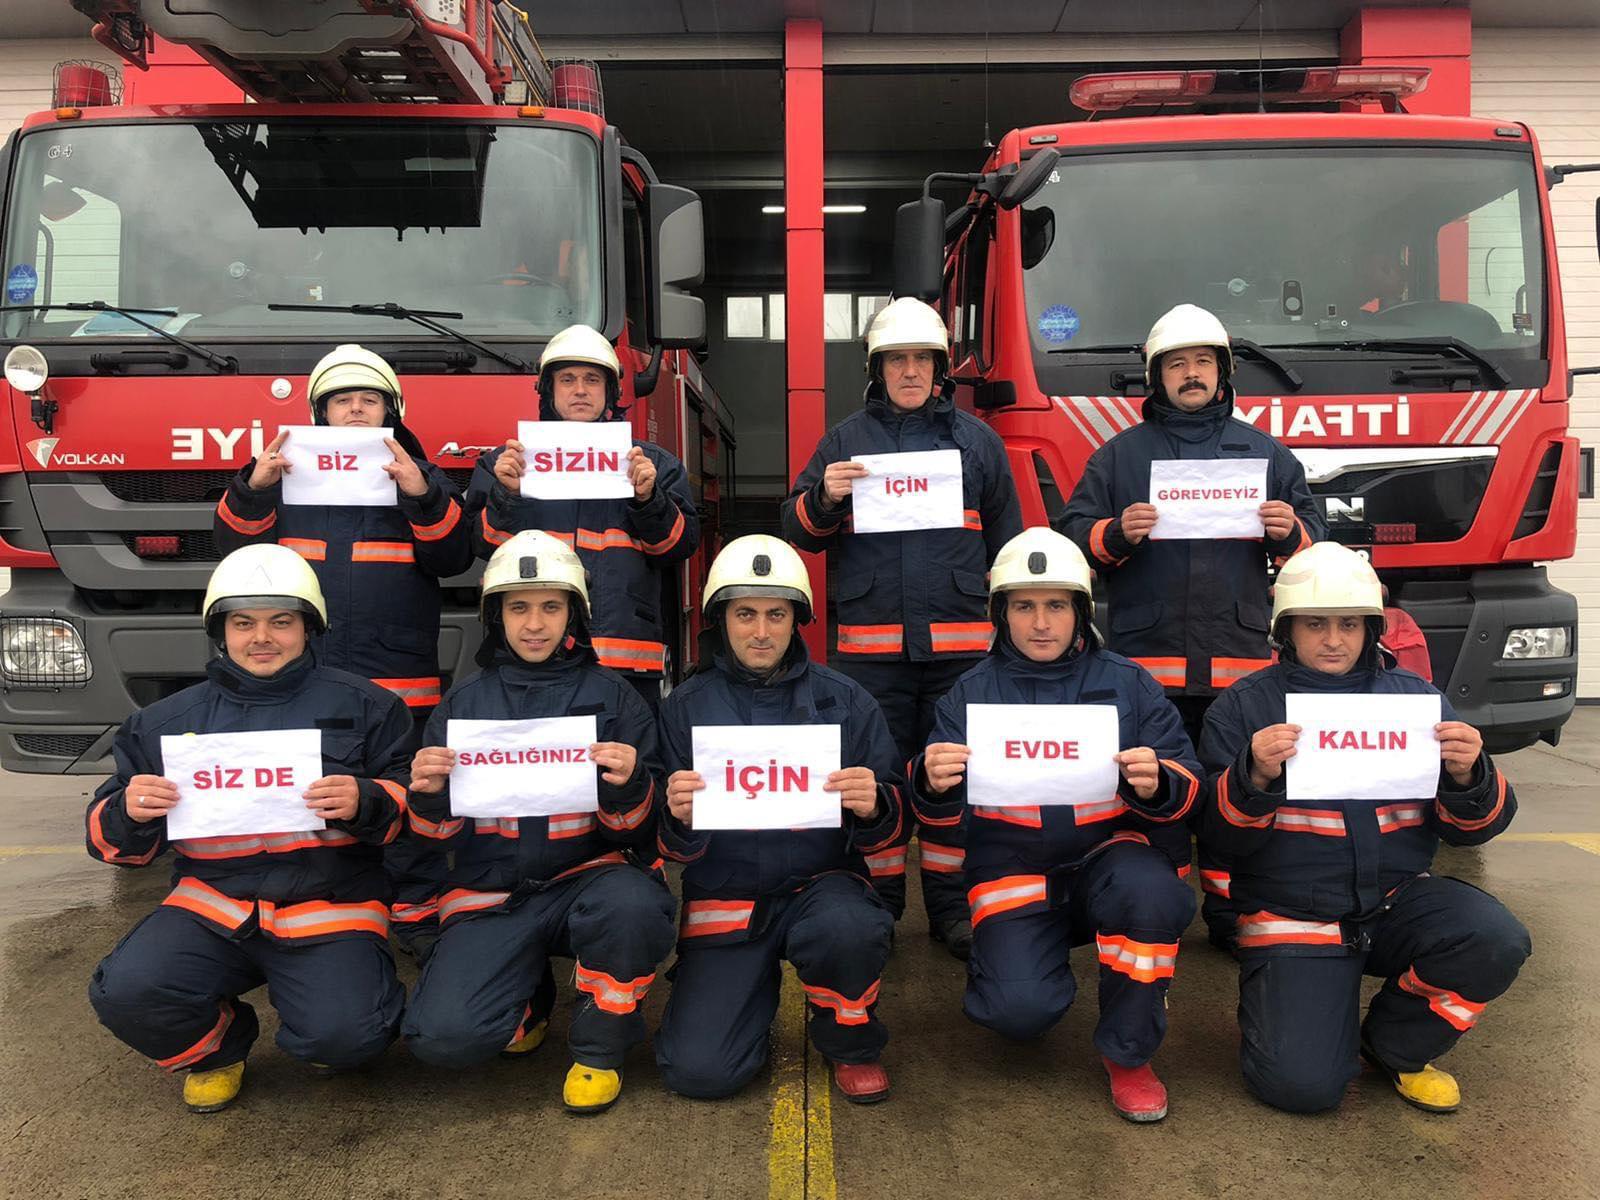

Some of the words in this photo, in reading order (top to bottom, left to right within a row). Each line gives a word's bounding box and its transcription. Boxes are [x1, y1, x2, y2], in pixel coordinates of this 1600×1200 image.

[53, 453, 125, 465] VOLKAN
[317, 454, 358, 472] BİZ
[534, 447, 619, 473] SİZİN
[885, 477, 929, 496] İÇİN
[1157, 486, 1259, 500] GÖREVDEYİZ
[1004, 740, 1079, 760] EVDE
[1318, 730, 1408, 751] KALIN
[459, 747, 587, 766] SAĞLIĞINIZ
[193, 765, 244, 791] SİZ
[254, 767, 295, 788] DE
[725, 759, 810, 800] İÇİN
